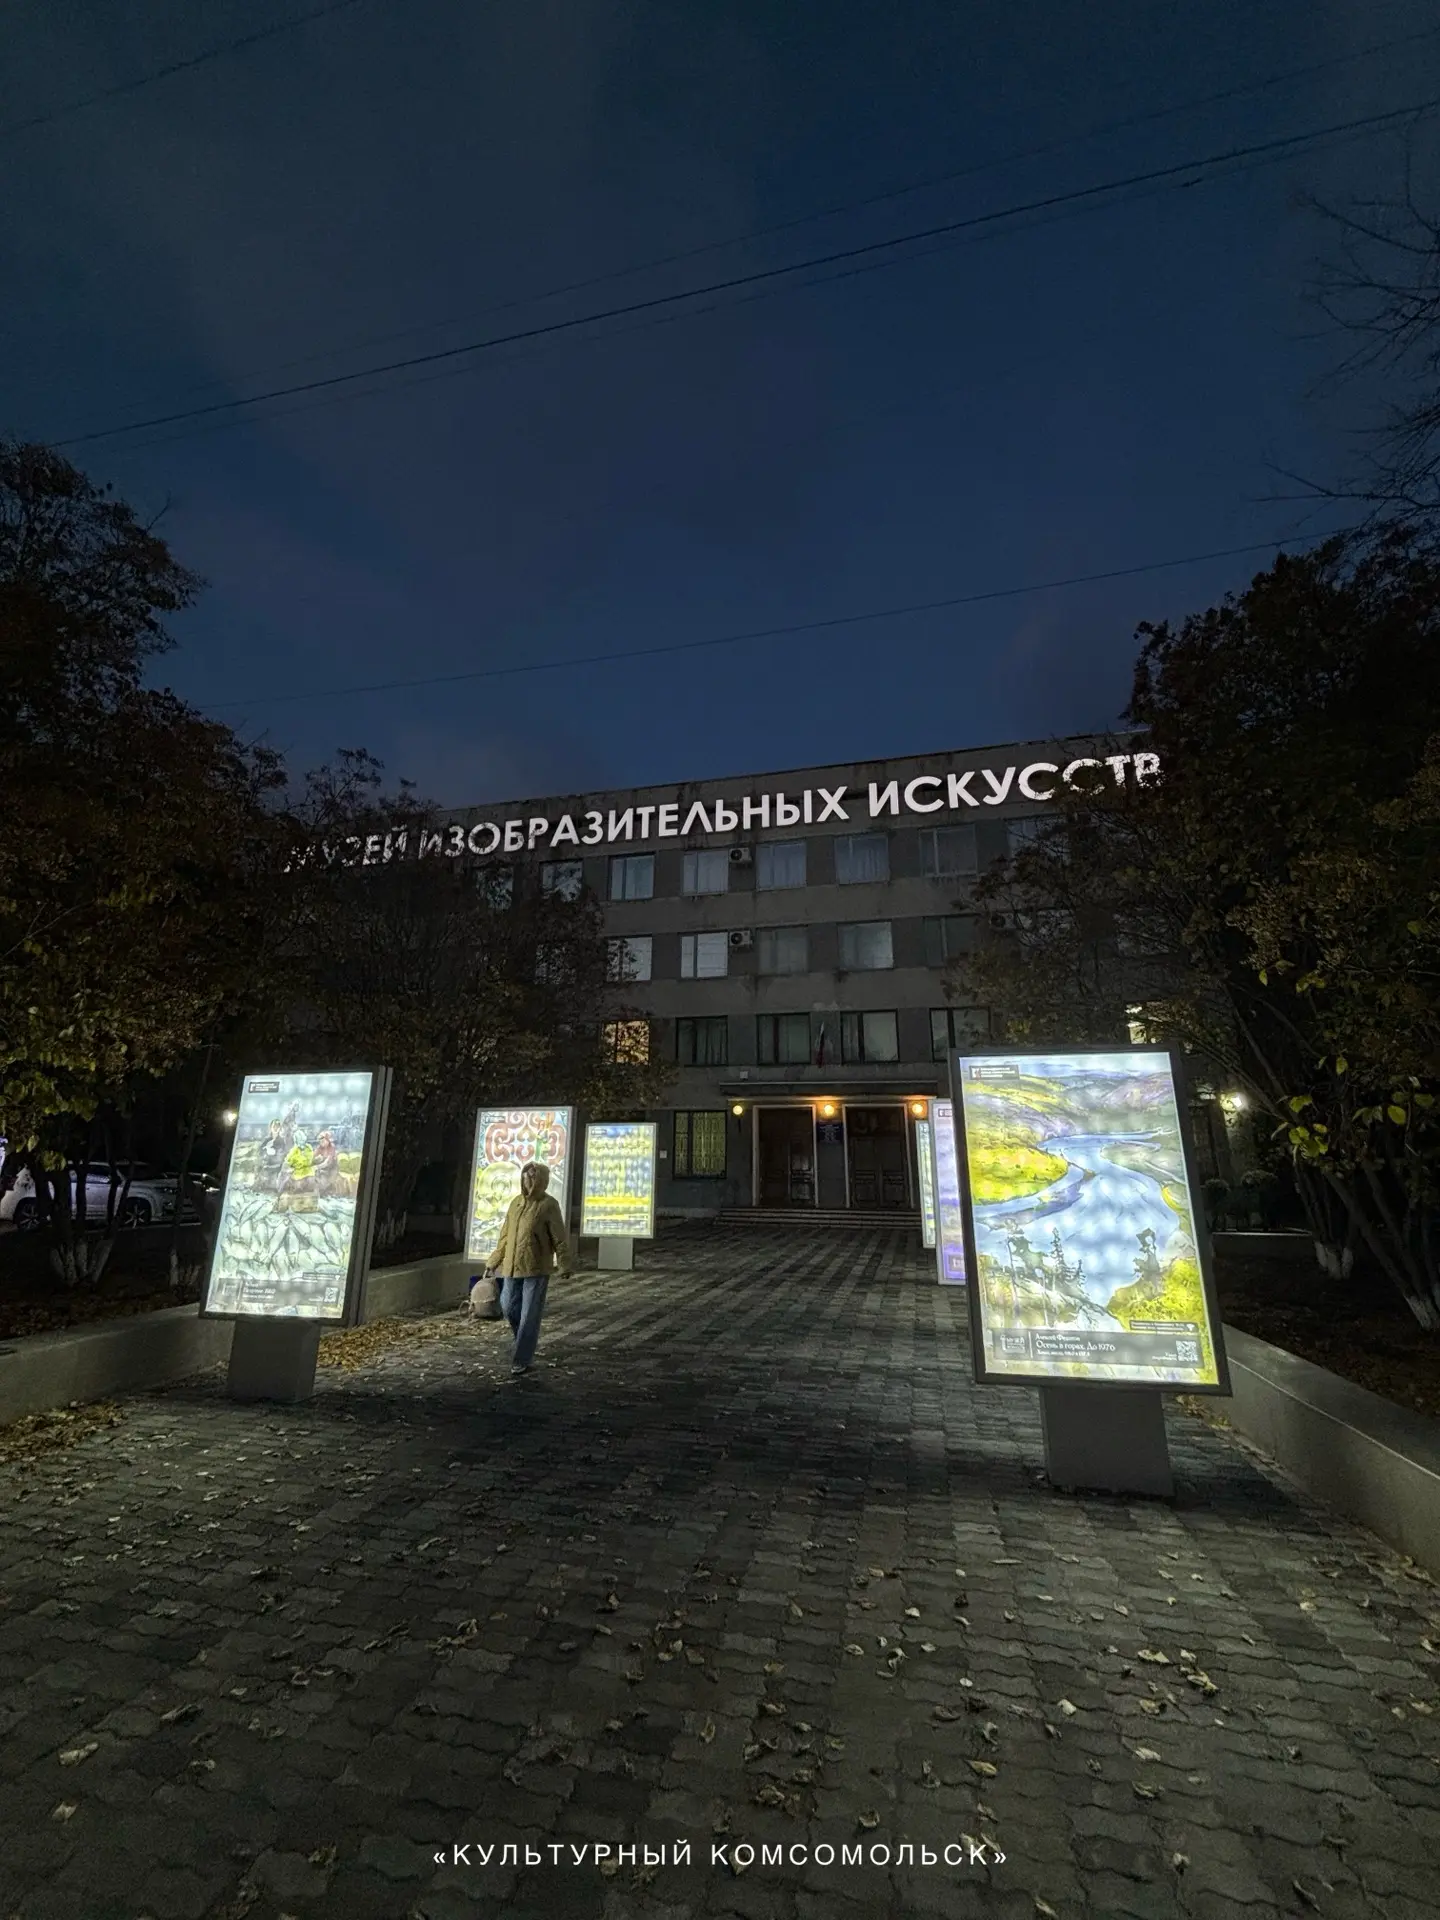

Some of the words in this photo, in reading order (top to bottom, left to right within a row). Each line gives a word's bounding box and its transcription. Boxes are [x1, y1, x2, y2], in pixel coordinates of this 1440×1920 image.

[283, 824, 408, 874] УЗЕЙ
[418, 785, 850, 860] ИЗОБРАЗИТЕЛЬНЫХ
[868, 752, 1163, 818] ИСКУССТВ
